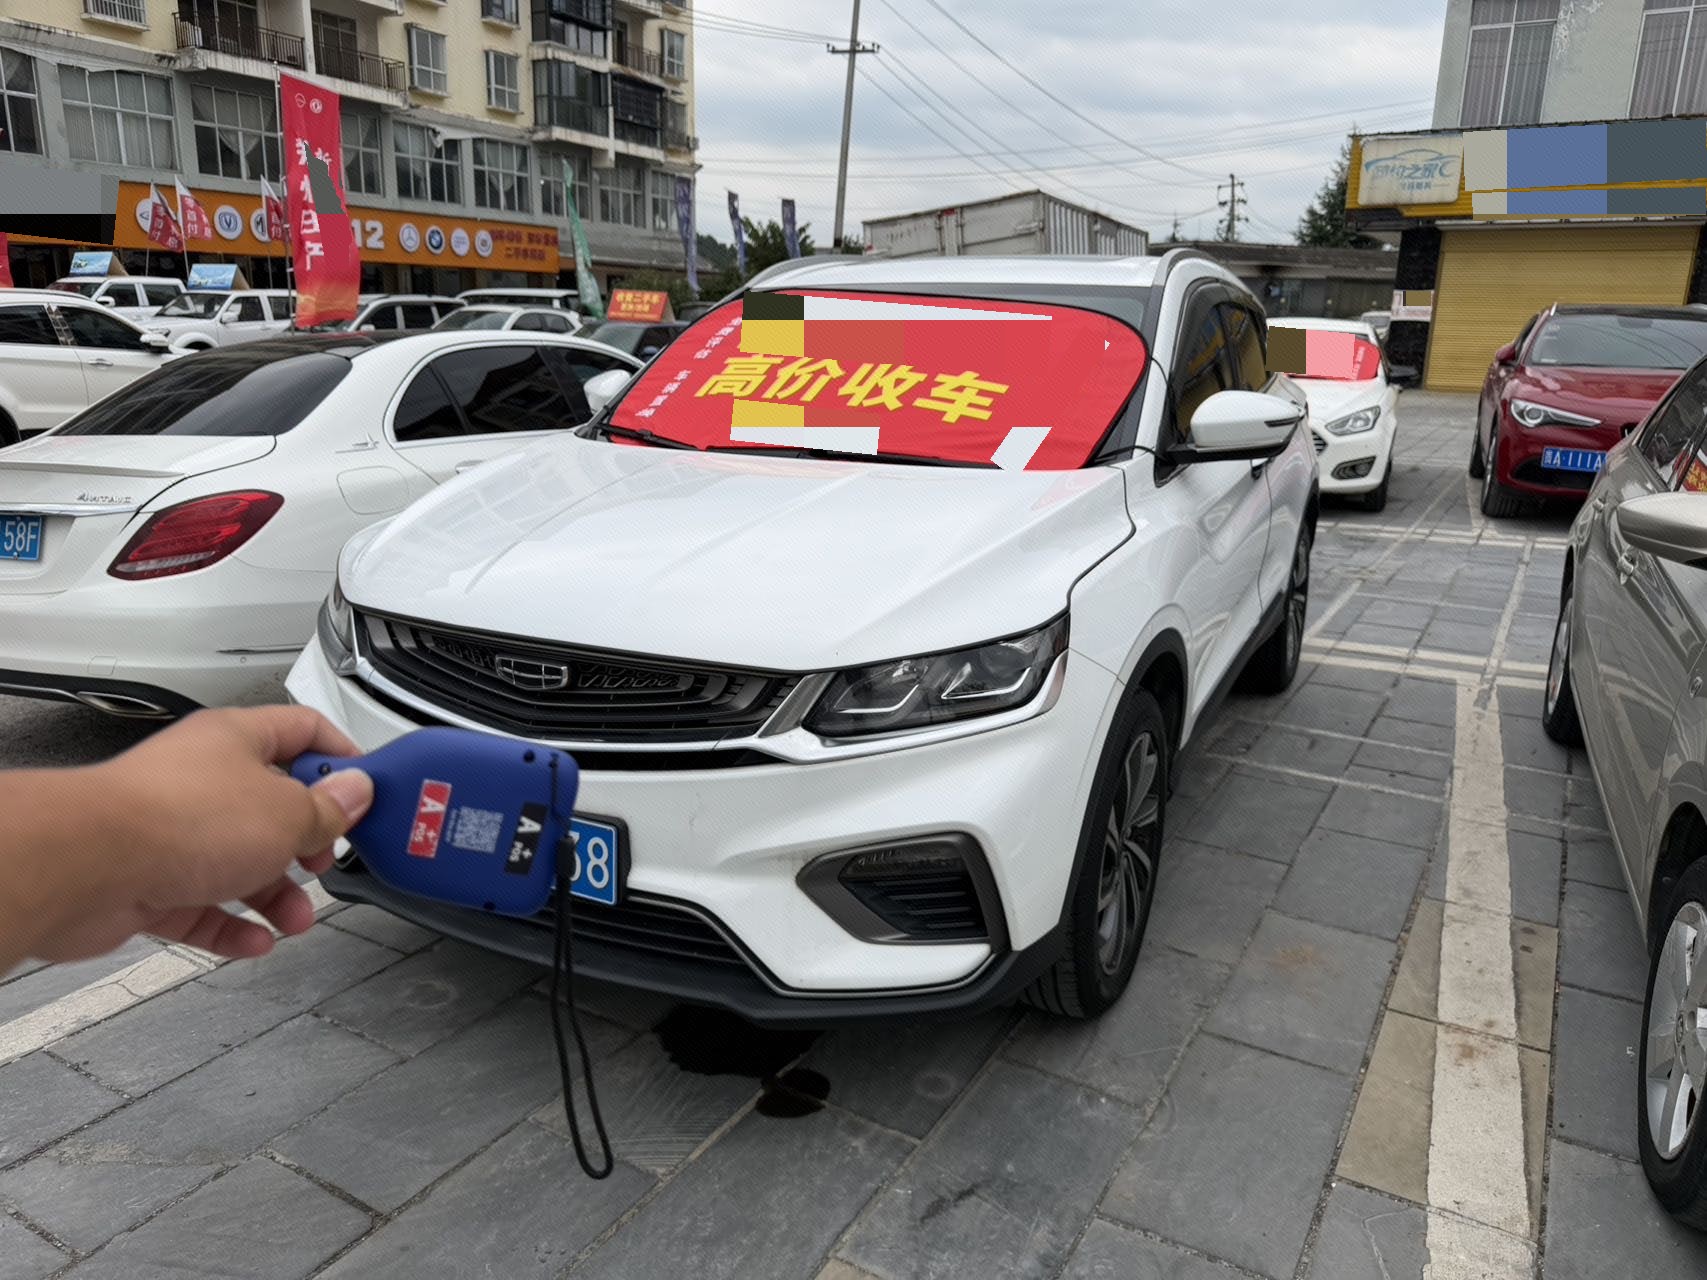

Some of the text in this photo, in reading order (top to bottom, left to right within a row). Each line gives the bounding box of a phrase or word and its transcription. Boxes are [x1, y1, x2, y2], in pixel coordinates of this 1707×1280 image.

[693, 353, 1010, 424] 高价收车
[3, 520, 39, 553] 58F
